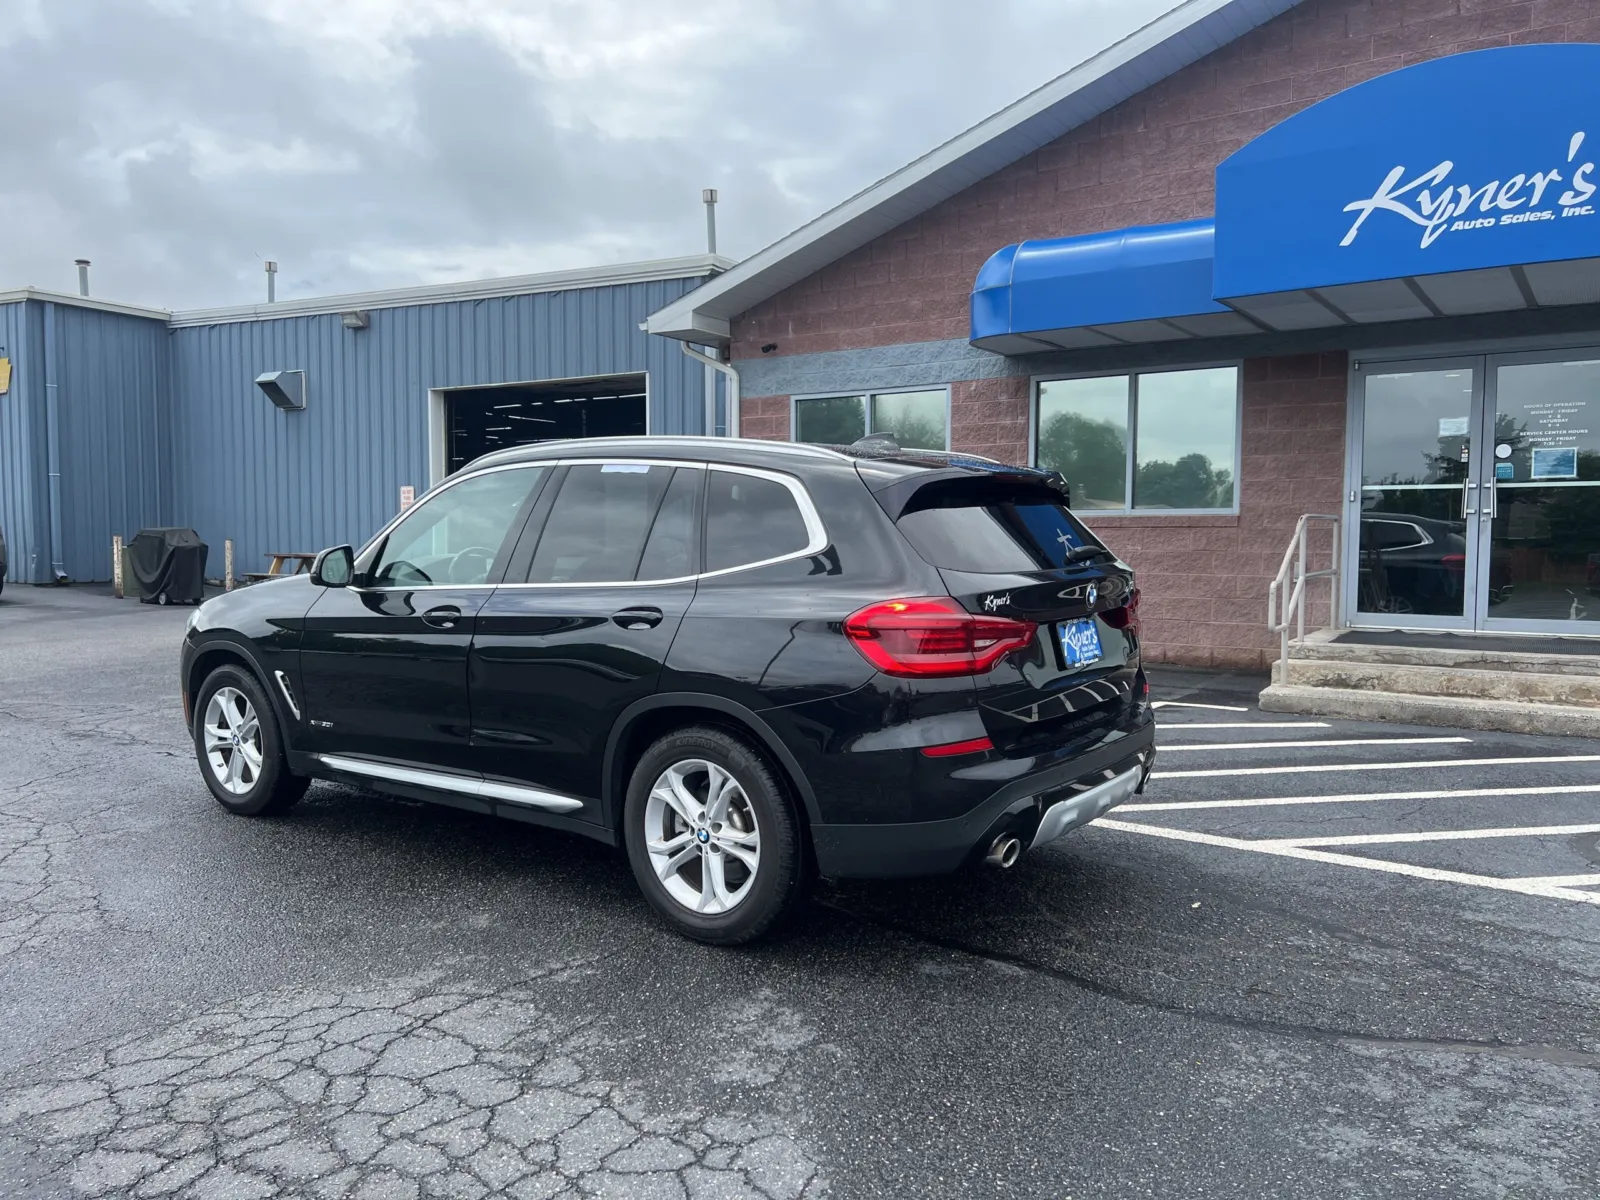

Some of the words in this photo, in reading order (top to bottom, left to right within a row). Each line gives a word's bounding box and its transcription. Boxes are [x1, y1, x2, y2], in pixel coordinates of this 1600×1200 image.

[1339, 131, 1597, 249] Kyner's
[1450, 218, 1496, 231] Auto
[1499, 209, 1556, 226] Sales,
[1561, 205, 1595, 218] Inc.
[1061, 623, 1098, 659] Kyner's
